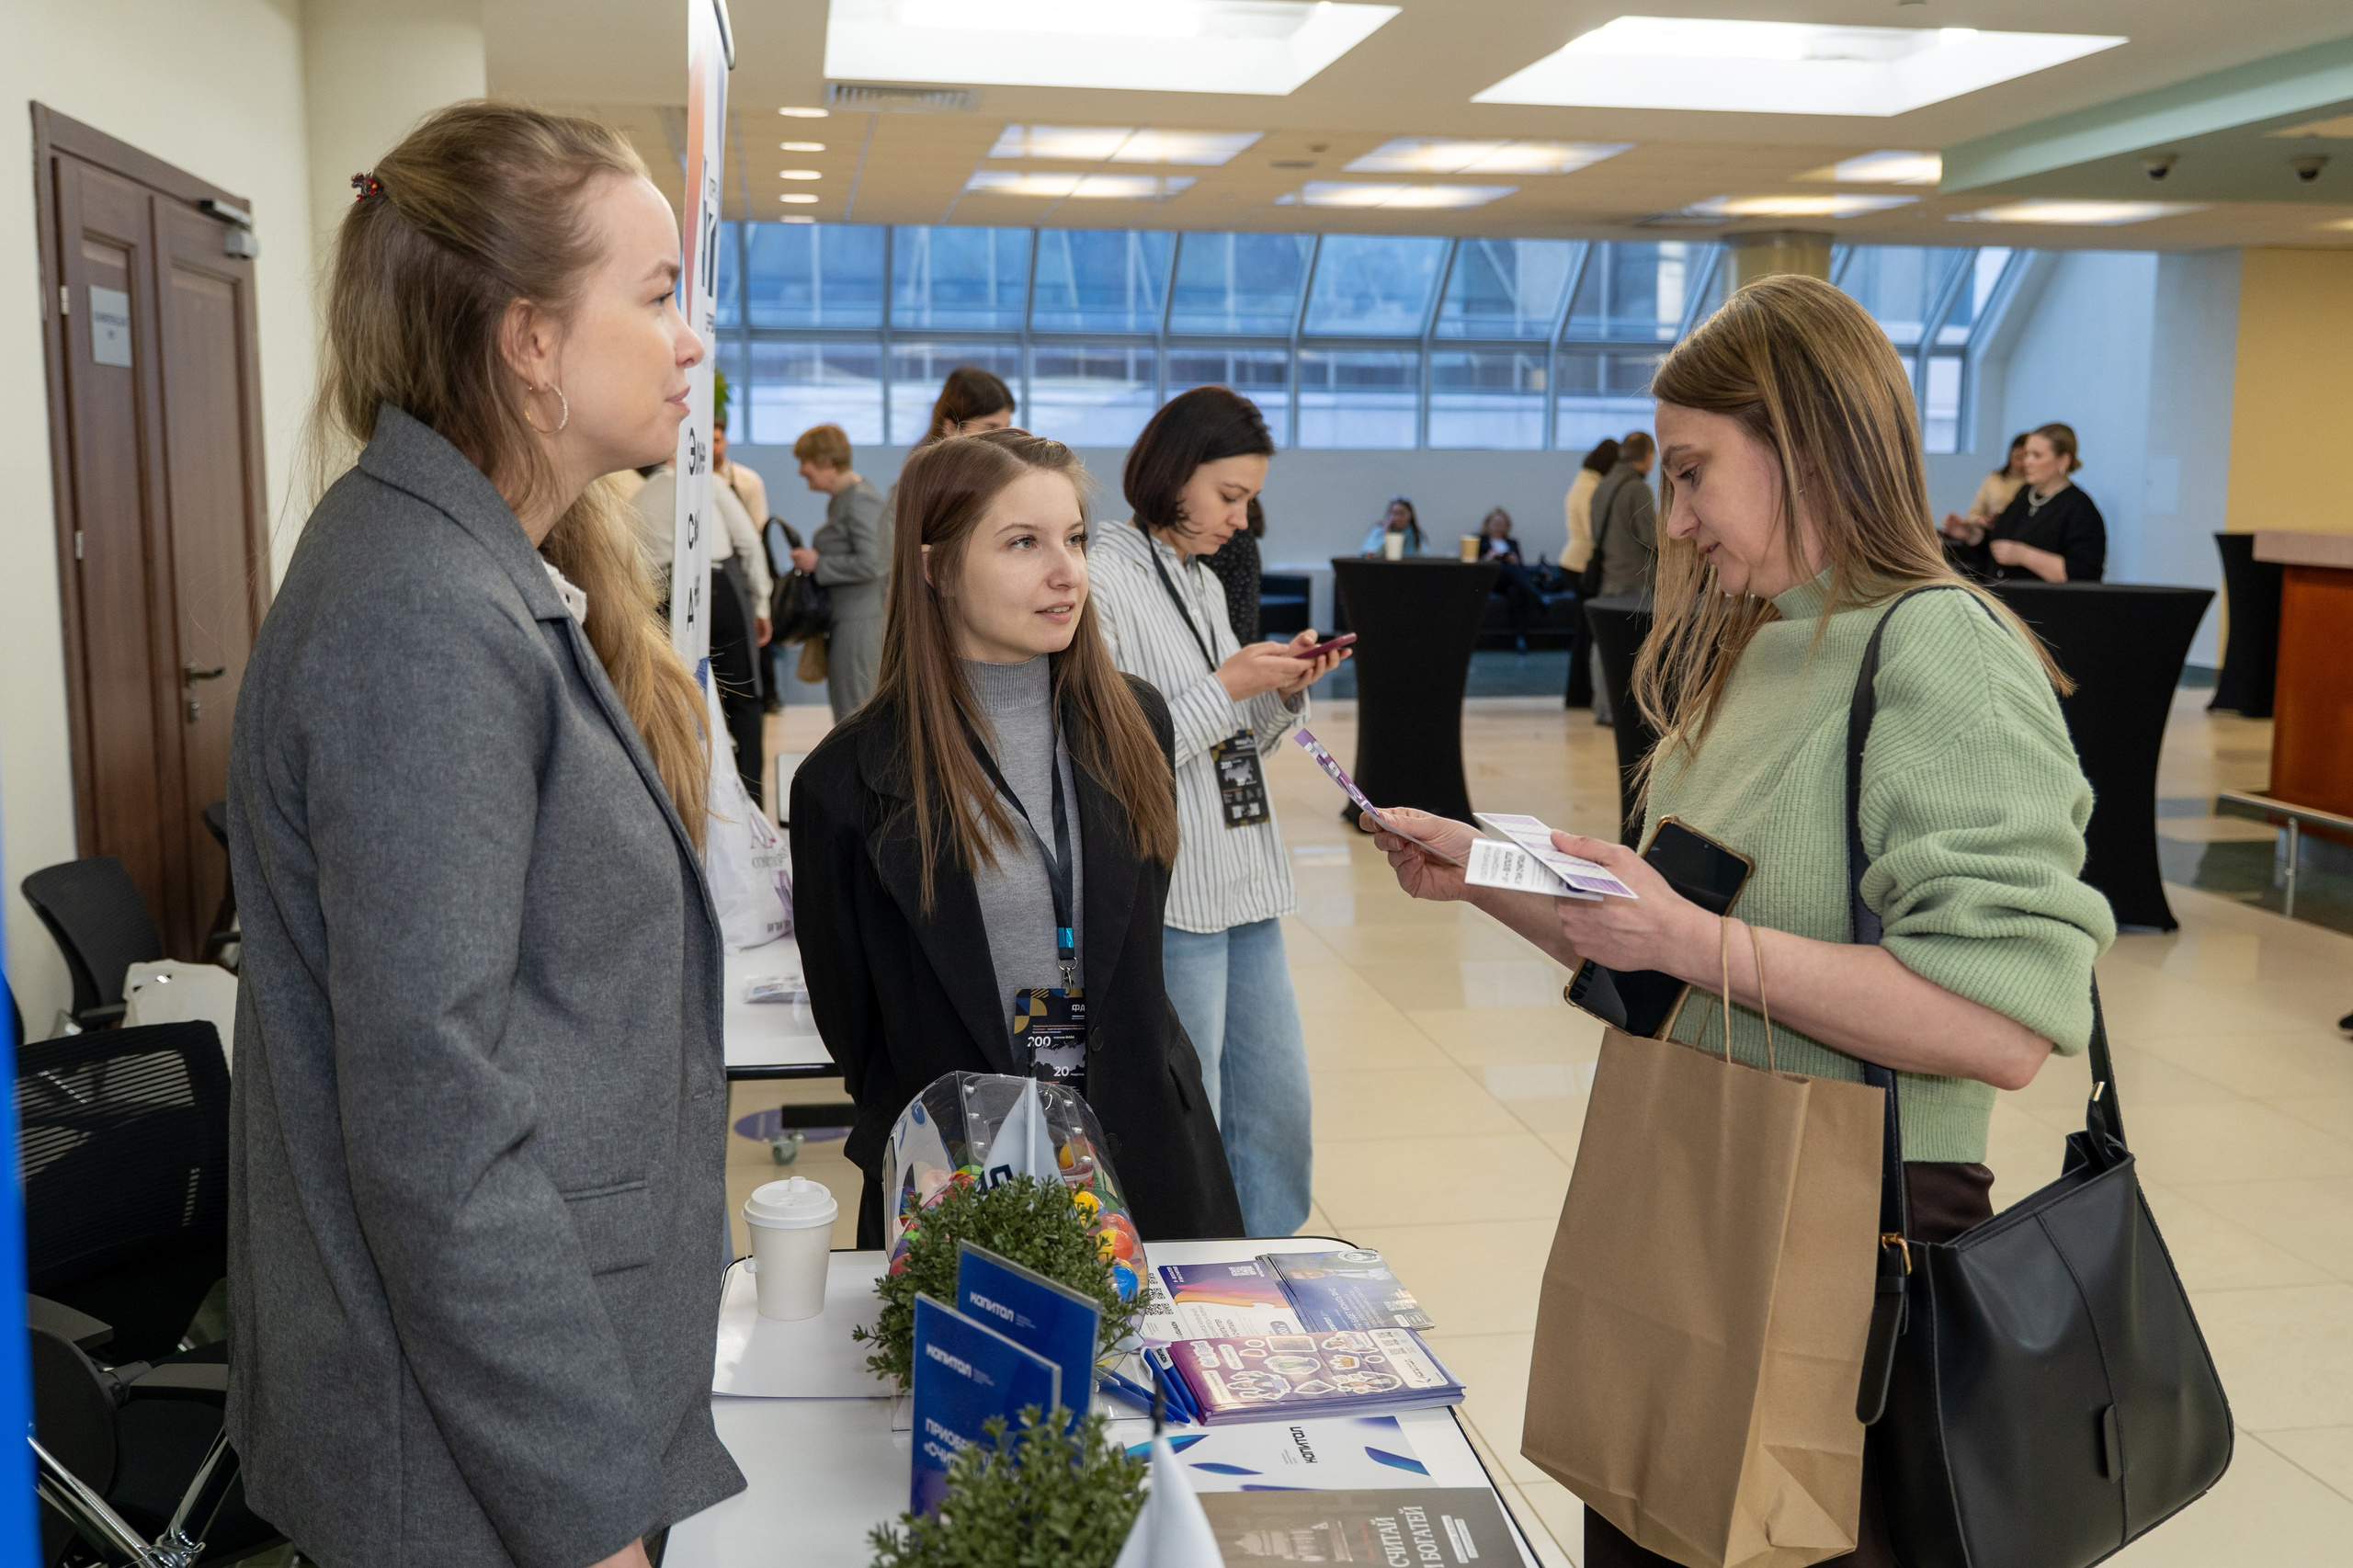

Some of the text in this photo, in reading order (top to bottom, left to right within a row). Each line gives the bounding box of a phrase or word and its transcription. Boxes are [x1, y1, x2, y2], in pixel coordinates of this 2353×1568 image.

[1027, 1036, 1051, 1048] 200
[1053, 1066, 1070, 1077] 20
[1370, 1517, 1410, 1568] СЧИТАЙ
[1398, 1506, 1443, 1562] БОГАТЕЙ
